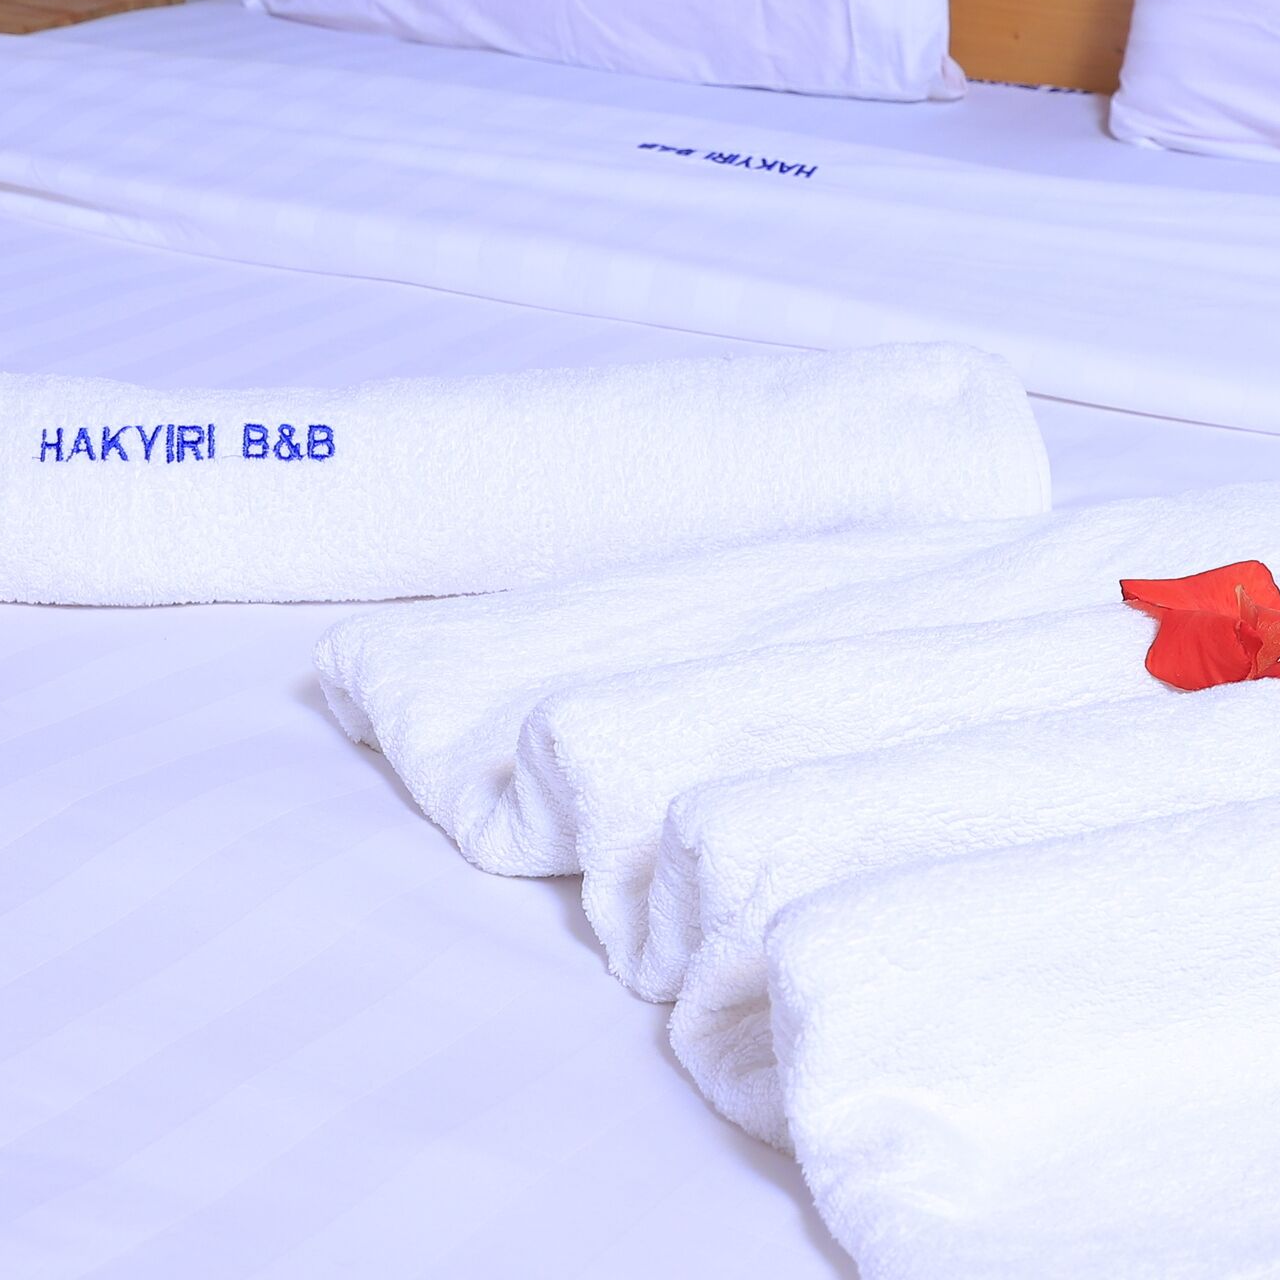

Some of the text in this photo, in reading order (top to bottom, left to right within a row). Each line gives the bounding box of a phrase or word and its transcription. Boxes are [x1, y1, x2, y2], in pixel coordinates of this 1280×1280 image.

[703, 151, 819, 179] HAKYIRI
[38, 422, 337, 465] HAKYIRI B&B
